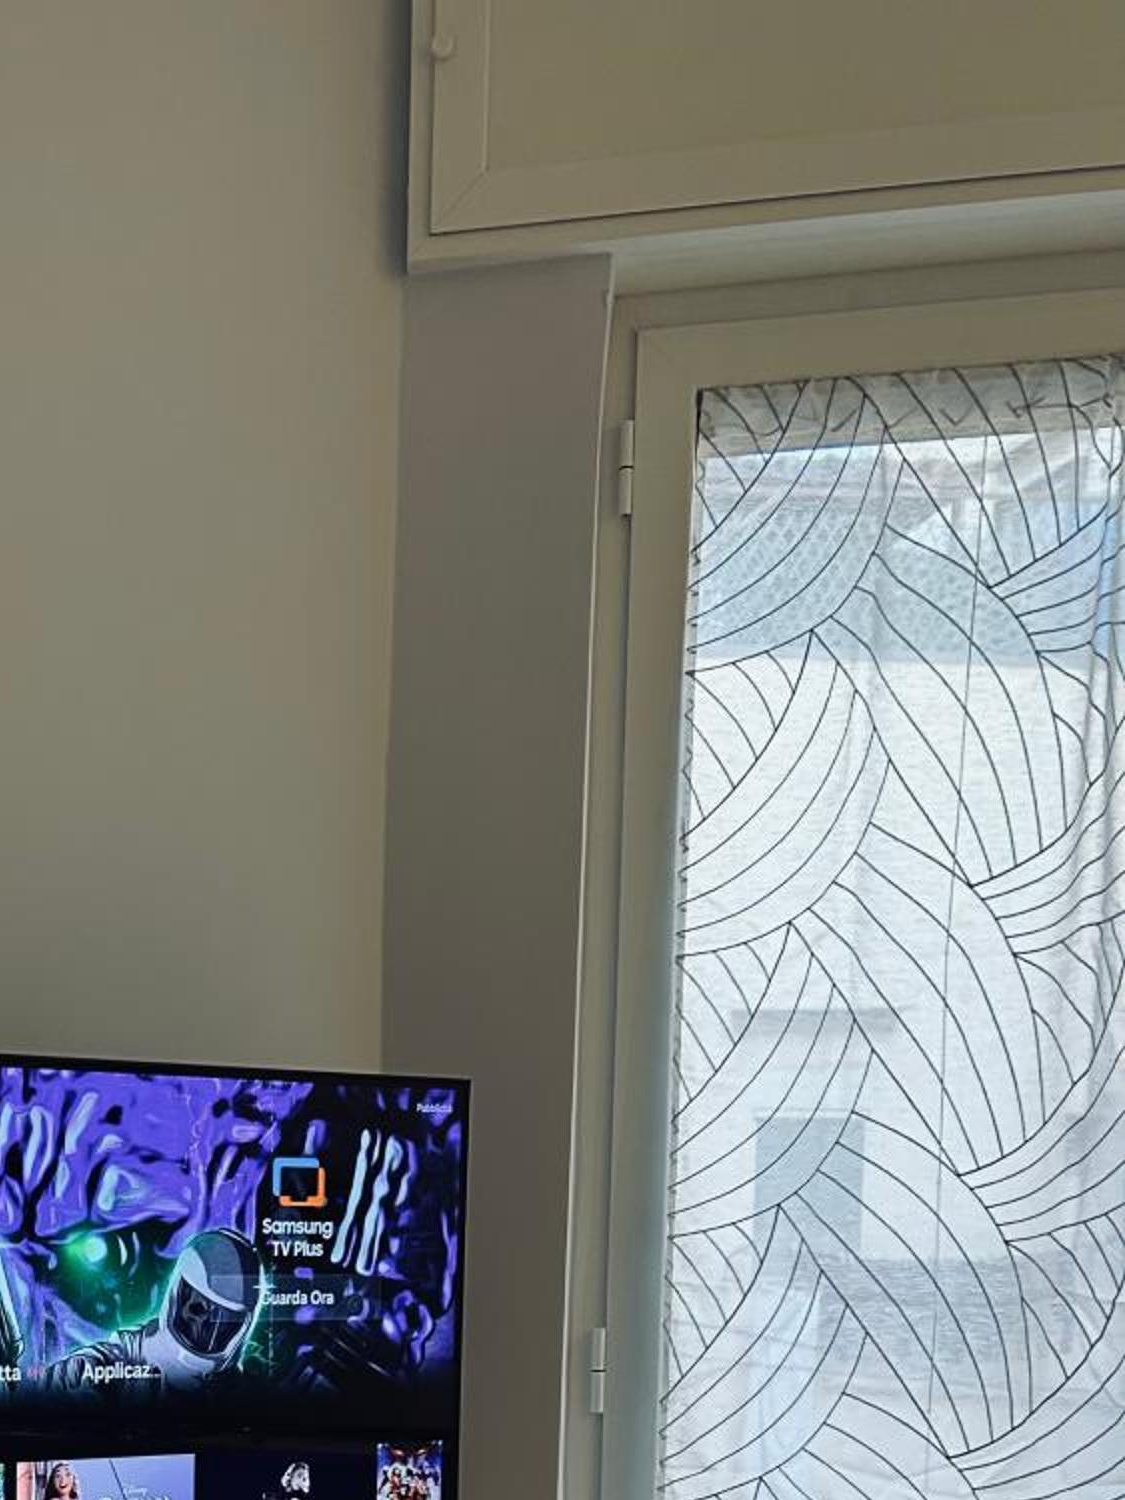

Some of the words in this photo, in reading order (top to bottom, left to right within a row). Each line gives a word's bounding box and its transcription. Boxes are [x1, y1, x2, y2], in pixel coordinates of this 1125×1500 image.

[262, 1218, 333, 1239] Samsung
[272, 1241, 292, 1257] TV
[294, 1241, 323, 1257] Plus
[262, 1290, 307, 1304] Guarda
[310, 1291, 334, 1305] Ora
